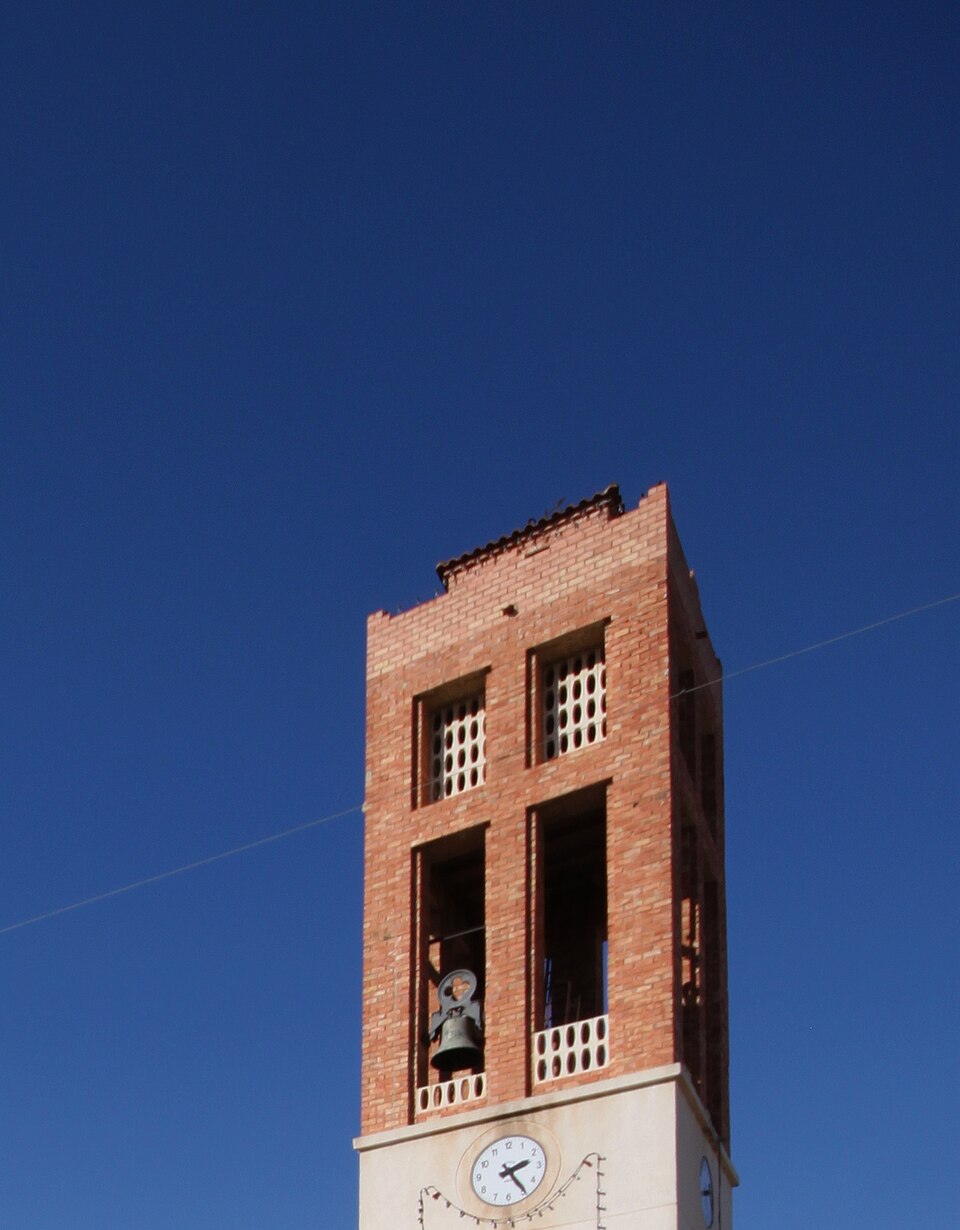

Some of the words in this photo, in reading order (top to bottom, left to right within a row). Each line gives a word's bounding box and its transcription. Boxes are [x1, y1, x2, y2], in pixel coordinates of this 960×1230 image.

[505, 1141, 512, 1150] 12
[492, 1149, 498, 1157] 11
[531, 1148, 537, 1156] 2
[481, 1160, 489, 1168] 10
[537, 1161, 542, 1169] 3
[476, 1173, 482, 1181] 9
[481, 1185, 487, 1193] 8
[506, 1193, 511, 1201] 6
